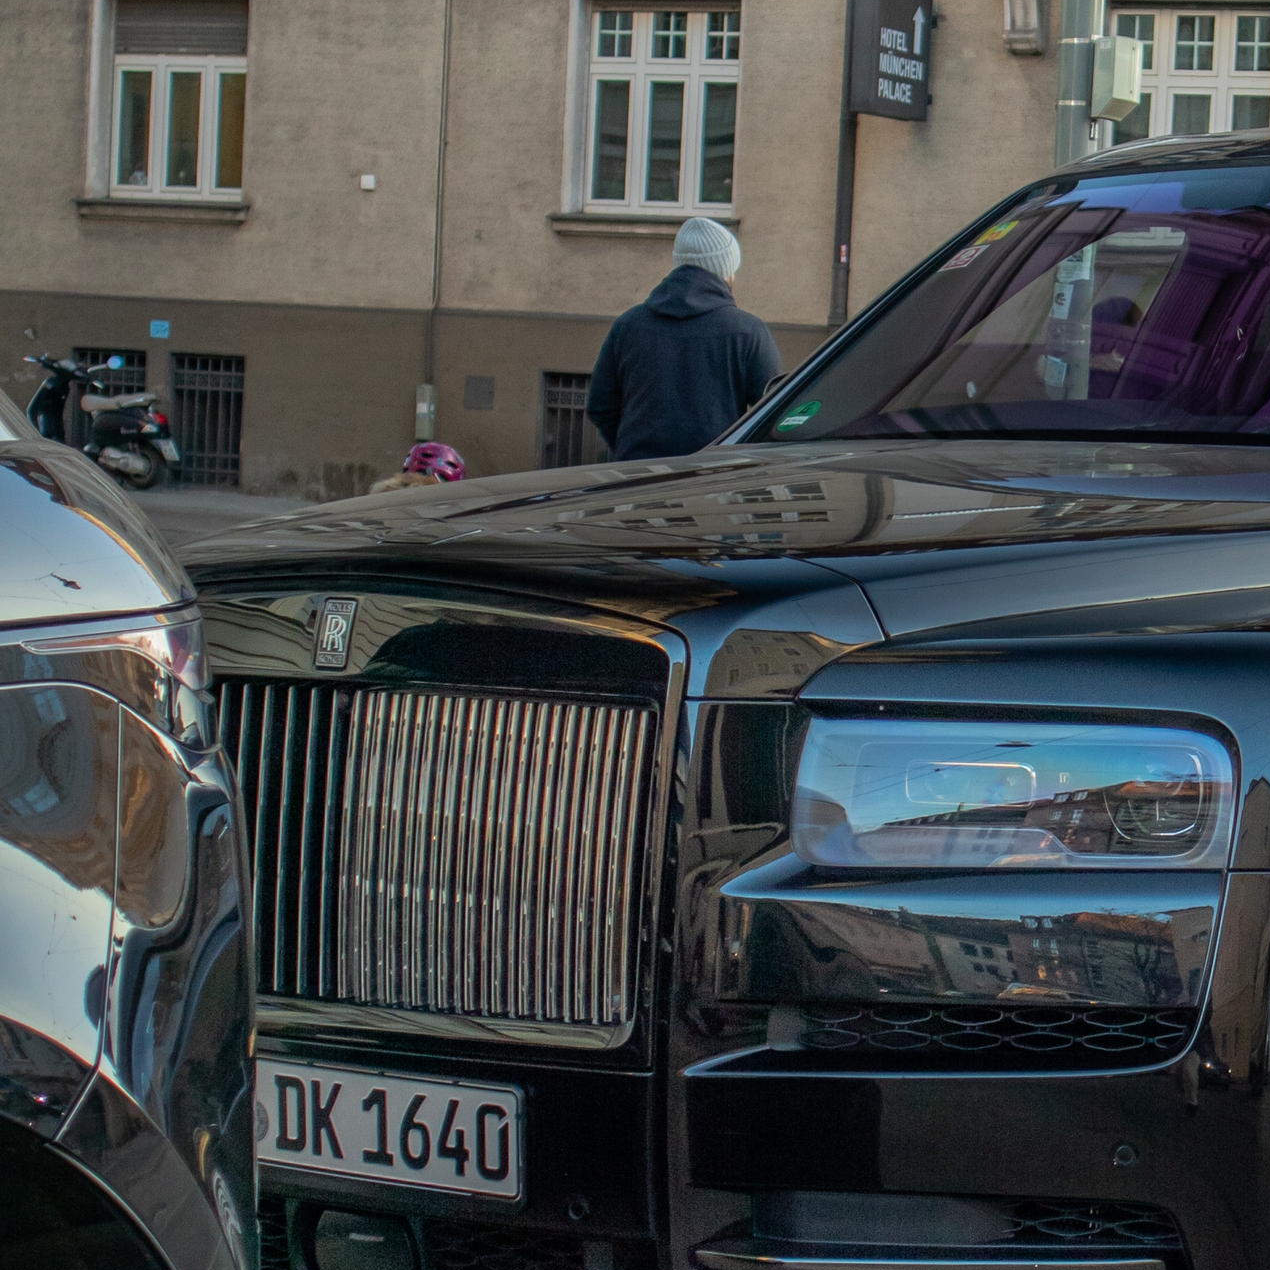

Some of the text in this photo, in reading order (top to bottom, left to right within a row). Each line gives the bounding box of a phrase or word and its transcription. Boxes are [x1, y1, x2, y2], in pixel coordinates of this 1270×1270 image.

[880, 27, 908, 52] HOTEL
[879, 50, 924, 81] MÜNCHEN
[878, 77, 912, 104] PALACE
[327, 603, 353, 612] ROLLS
[274, 1074, 509, 1182] DK 1640
